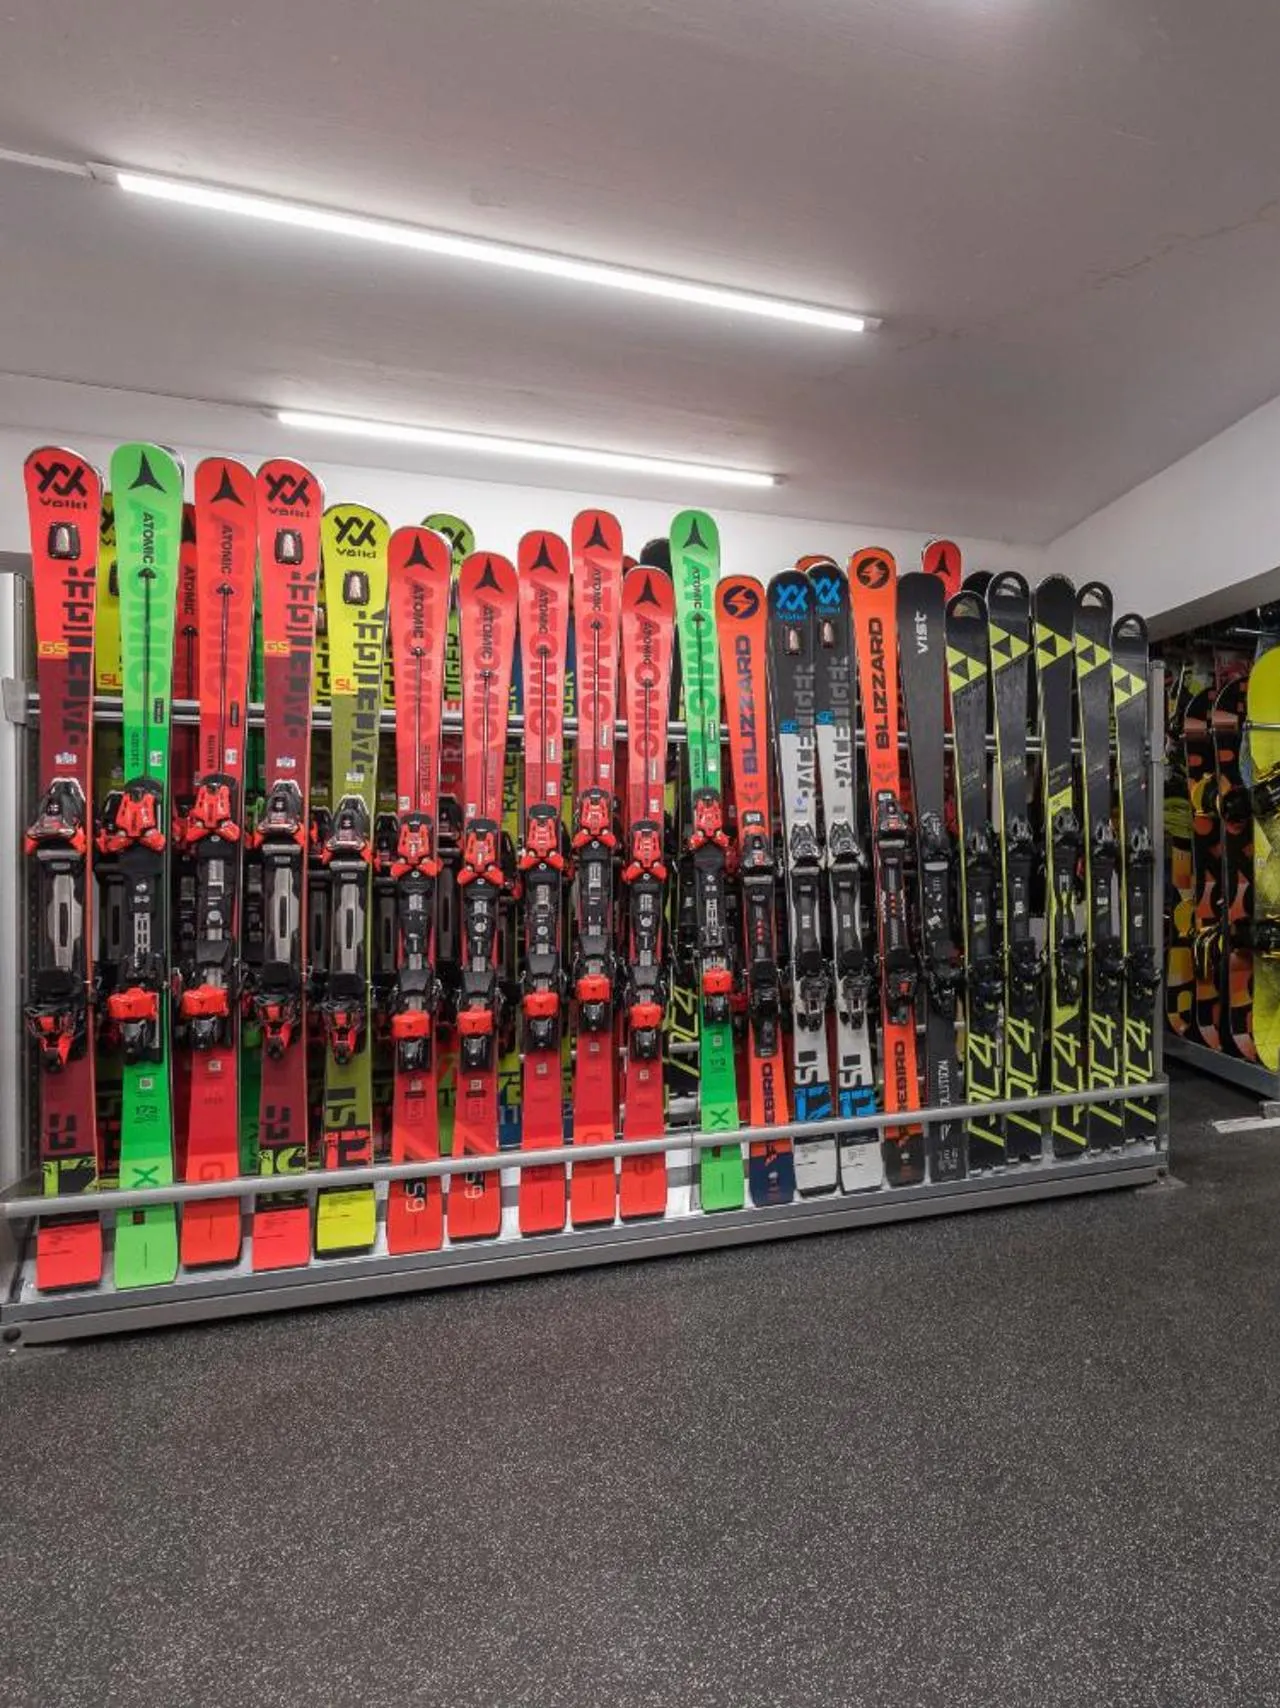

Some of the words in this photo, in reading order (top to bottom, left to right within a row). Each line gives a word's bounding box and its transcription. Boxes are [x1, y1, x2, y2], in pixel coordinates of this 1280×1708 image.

[143, 511, 155, 565] ATOMIC
[220, 525, 232, 576] ATOMIC
[184, 565, 195, 616] ATOMIC
[412, 583, 425, 640] ATOMIC
[538, 589, 548, 635] ATOMIC
[591, 567, 601, 613] ATOMIC
[692, 566, 703, 609] ATOMIC
[480, 604, 494, 668] ATOMIC
[643, 621, 652, 665] ATOMIC
[735, 635, 758, 775] BLIZZARD
[868, 617, 890, 749] BLIZZARD
